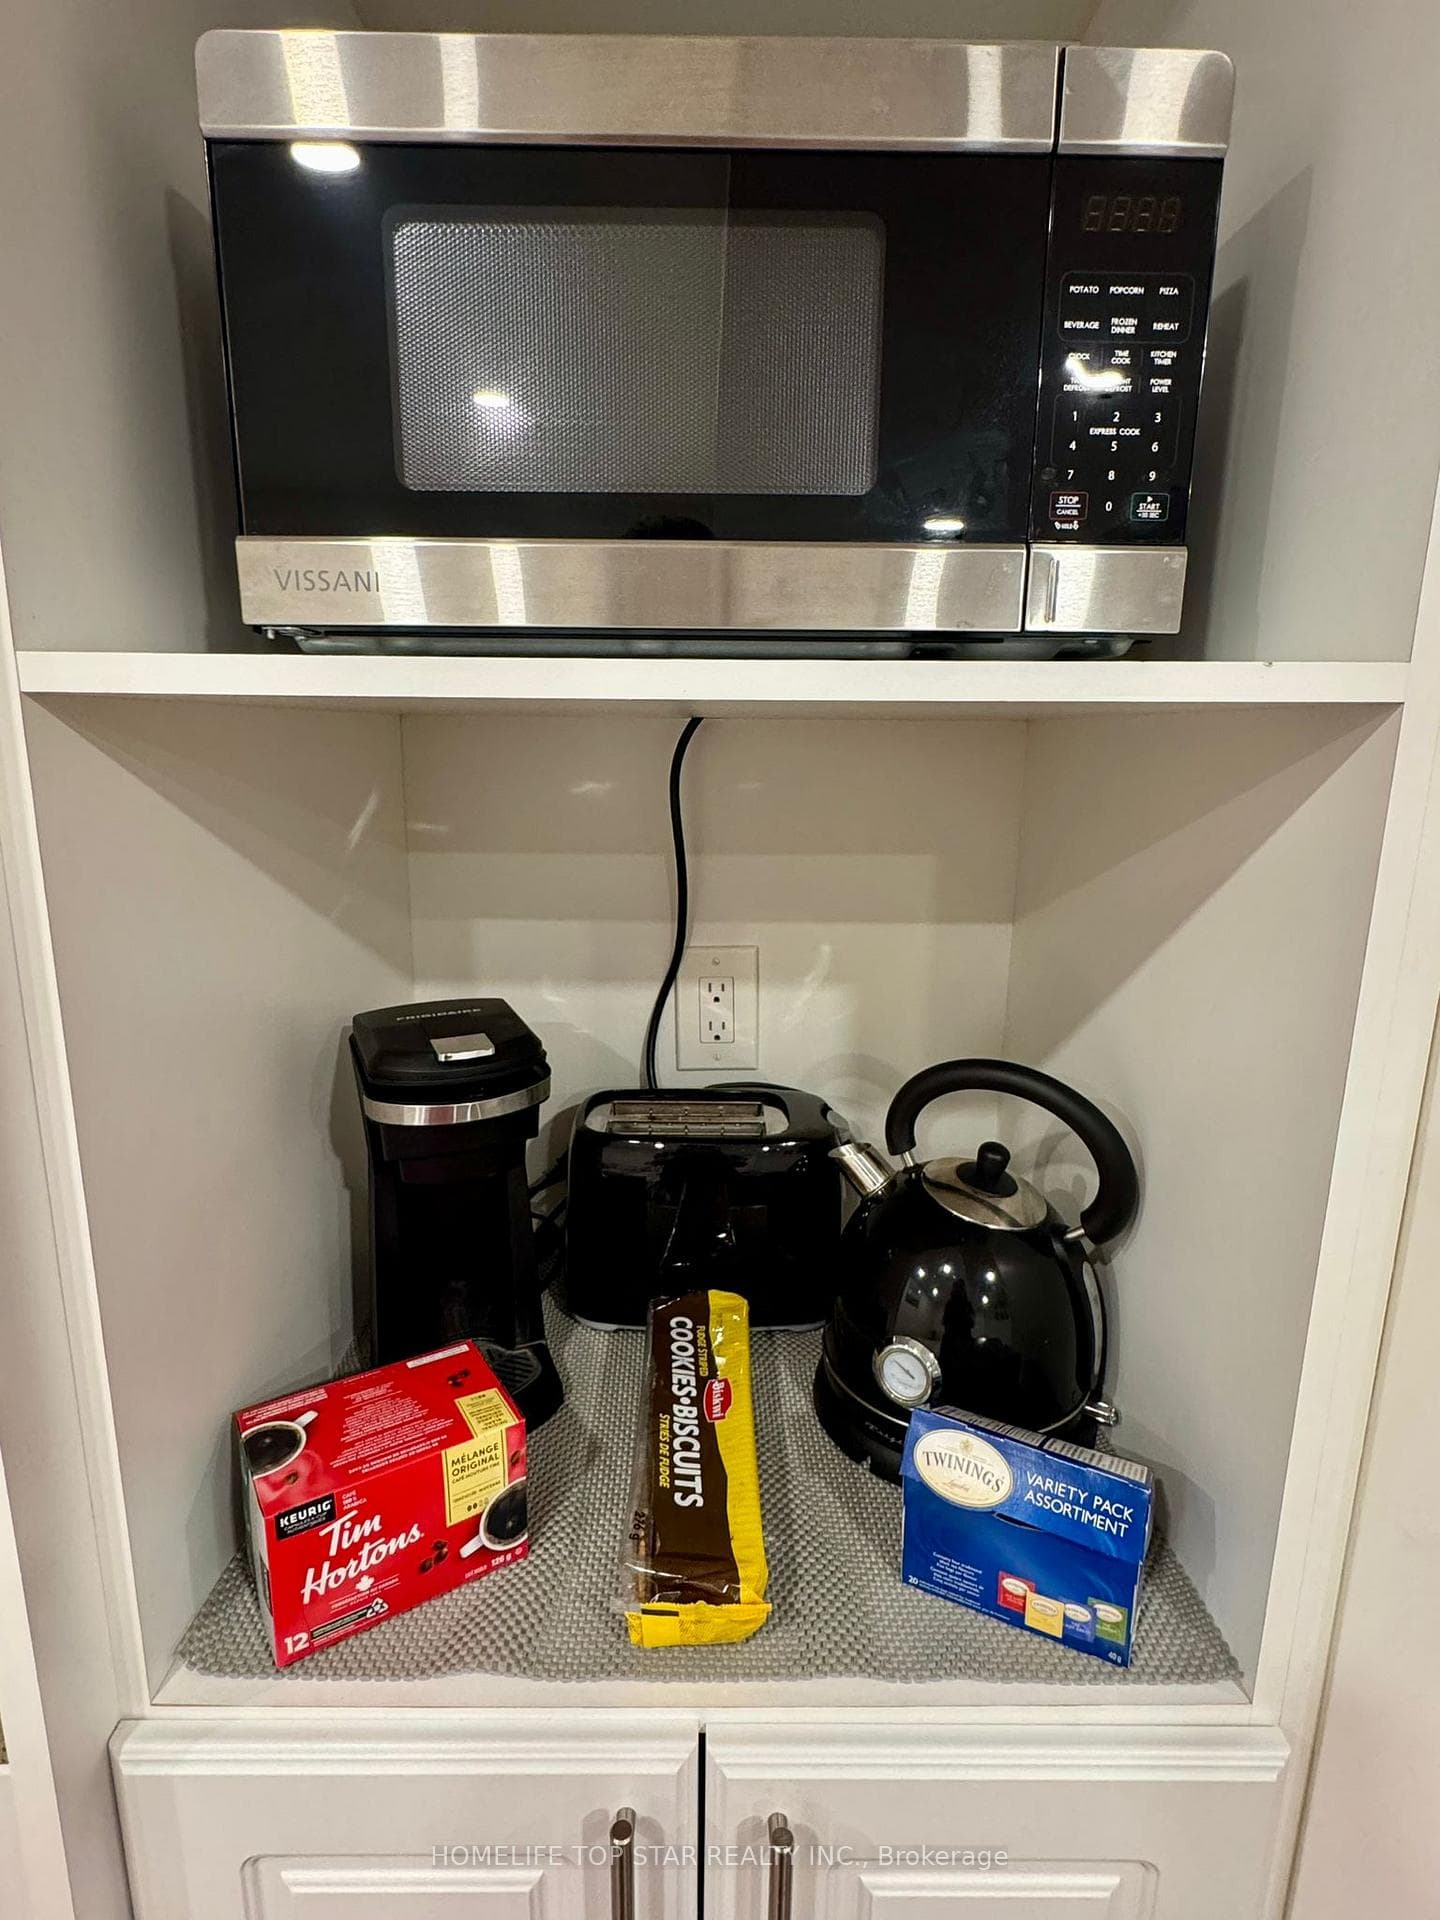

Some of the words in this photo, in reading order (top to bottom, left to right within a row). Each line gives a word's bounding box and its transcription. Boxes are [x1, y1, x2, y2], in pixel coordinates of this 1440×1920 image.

[1069, 285, 1099, 294] POTATO
[1109, 286, 1144, 295] POPCORN
[1159, 287, 1179, 295] PIZZA
[1064, 321, 1099, 330] BEVERAGE
[1111, 317, 1137, 326] FROZEN
[1153, 322, 1179, 331] REHEAT
[1111, 326, 1135, 335] DINNER
[1068, 352, 1090, 361] CLOCK
[1150, 378, 1172, 386] POWER
[1063, 384, 1091, 392] DEFRO
[1103, 385, 1132, 393] FROST
[1072, 411, 1077, 422] 1
[1113, 411, 1120, 422] 2
[1154, 412, 1161, 423] 3
[1089, 428, 1117, 436] EXPRESS
[1119, 428, 1141, 436] COOK
[1069, 440, 1076, 451] 4
[1111, 441, 1118, 452] 5
[1151, 442, 1159, 452] 6
[1067, 469, 1074, 480] 7
[1108, 470, 1115, 481] 8
[1149, 471, 1156, 481] 9
[1058, 496, 1079, 504] STOP
[1105, 501, 1112, 512] 0
[273, 569, 380, 592] VISSANI
[696, 1325, 707, 1347] FUDGE
[670, 1316, 697, 1397] COOKIES
[659, 1413, 672, 1442] STRIÉS
[451, 1442, 499, 1467] MÉLANGE
[659, 1443, 670, 1456] DE
[672, 1404, 704, 1508] BISCUITS
[451, 1453, 500, 1477] ORIGINAL
[659, 1457, 670, 1489] FUDGE
[923, 1451, 1004, 1492] TWININGS
[1027, 1471, 1088, 1505] VARIETY
[1093, 1496, 1133, 1522] PACK
[280, 1501, 331, 1527] KEURIG
[1024, 1490, 1129, 1537] ASSORTIMENT
[319, 1510, 381, 1556] Tim
[629, 1533, 639, 1541] g
[301, 1525, 420, 1604] Hortons
[908, 1575, 919, 1585] 20
[284, 1631, 310, 1655] 12
